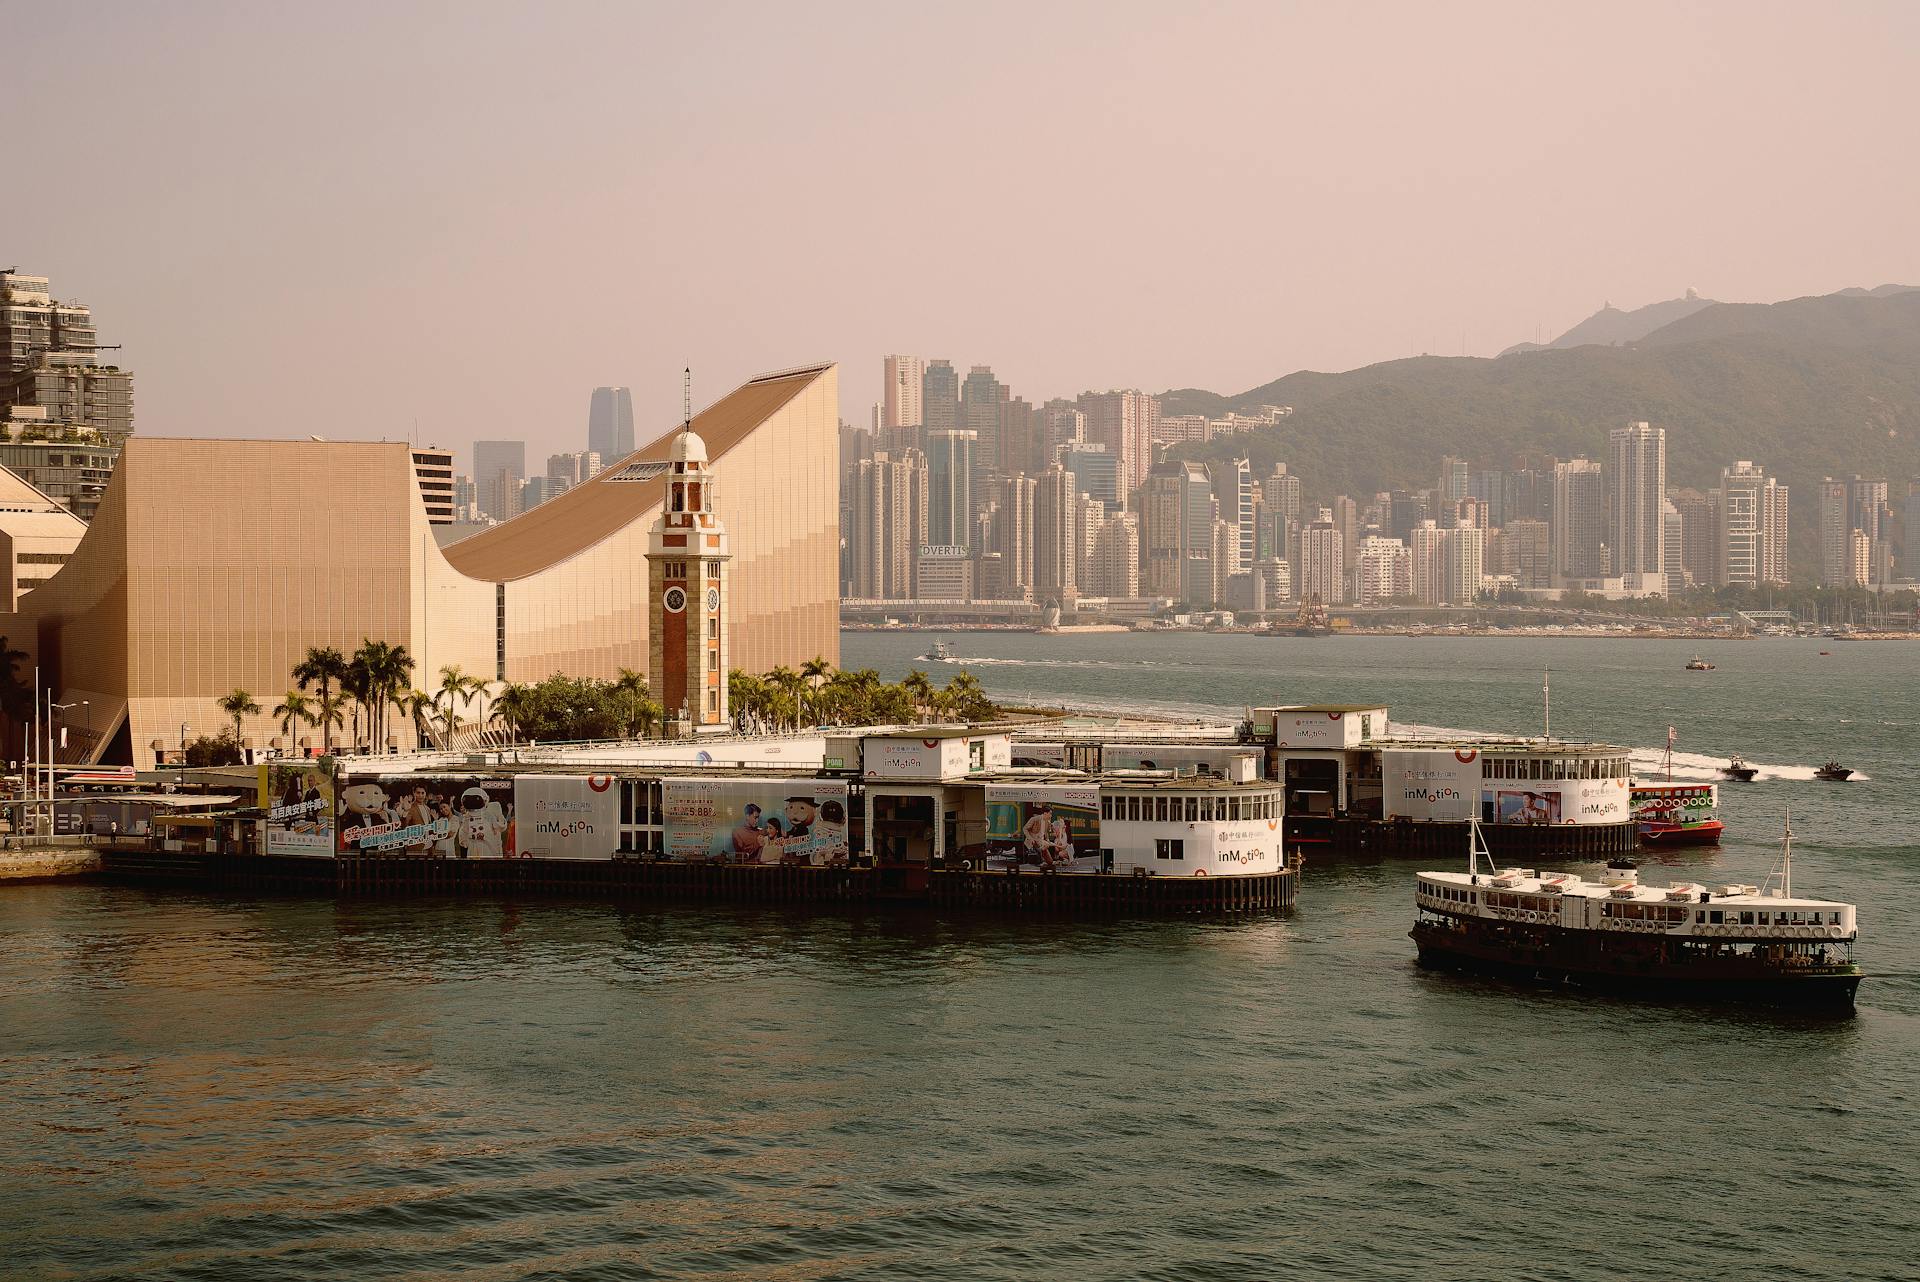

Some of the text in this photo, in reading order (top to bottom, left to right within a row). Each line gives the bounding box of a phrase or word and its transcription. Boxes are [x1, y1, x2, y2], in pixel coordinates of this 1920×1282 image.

[885, 758, 920, 768] inMotion
[1405, 788, 1459, 802] inMotion
[1581, 802, 1618, 816] inMotion
[536, 821, 593, 837] inMotion
[1218, 848, 1264, 864] inMotion
